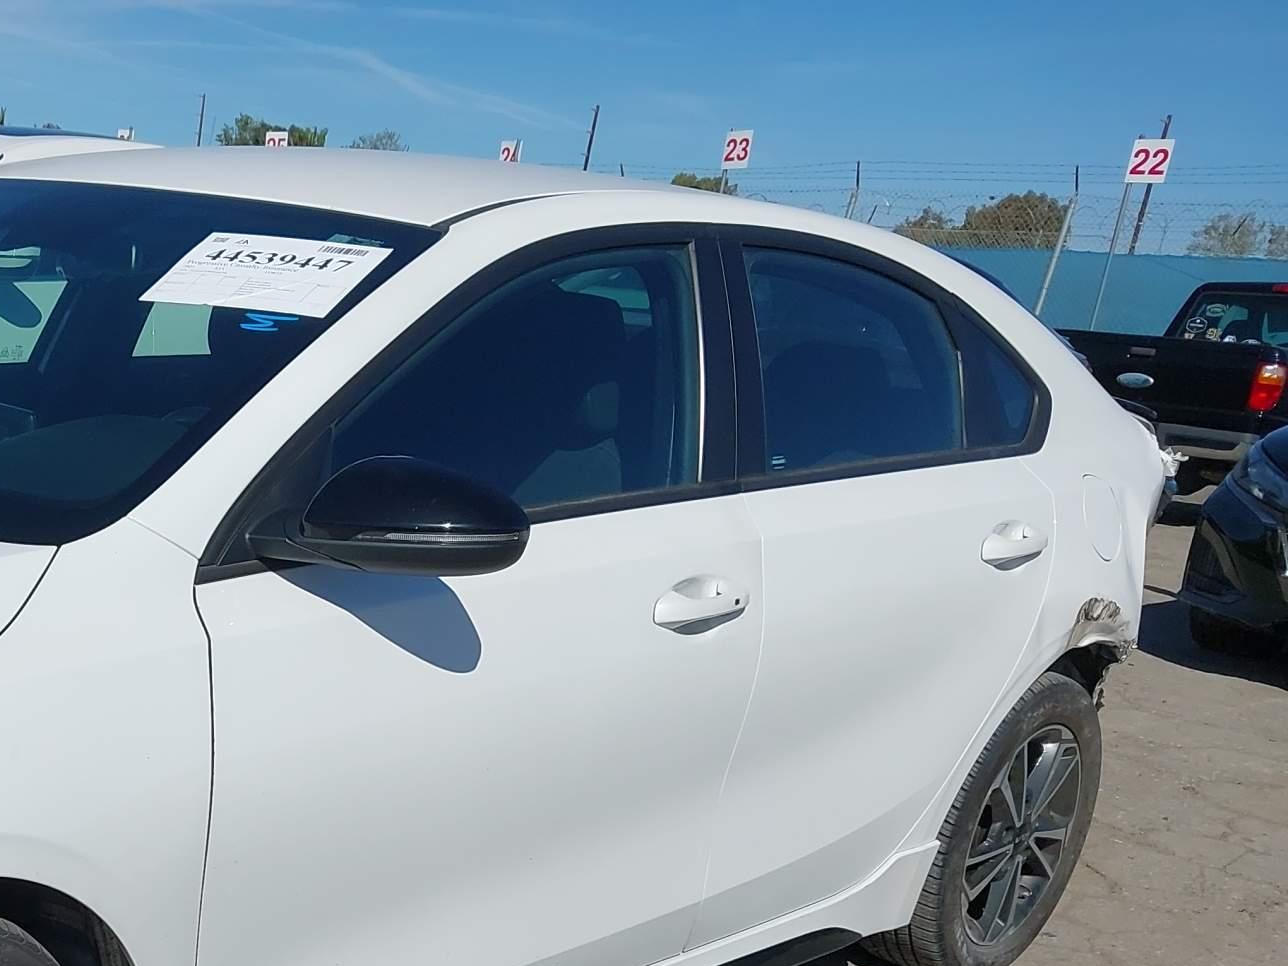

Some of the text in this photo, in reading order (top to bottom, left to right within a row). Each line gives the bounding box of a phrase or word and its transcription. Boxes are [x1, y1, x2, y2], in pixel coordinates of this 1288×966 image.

[724, 138, 749, 161] 23
[1129, 148, 1169, 175] 22
[206, 248, 355, 272] 44539447
